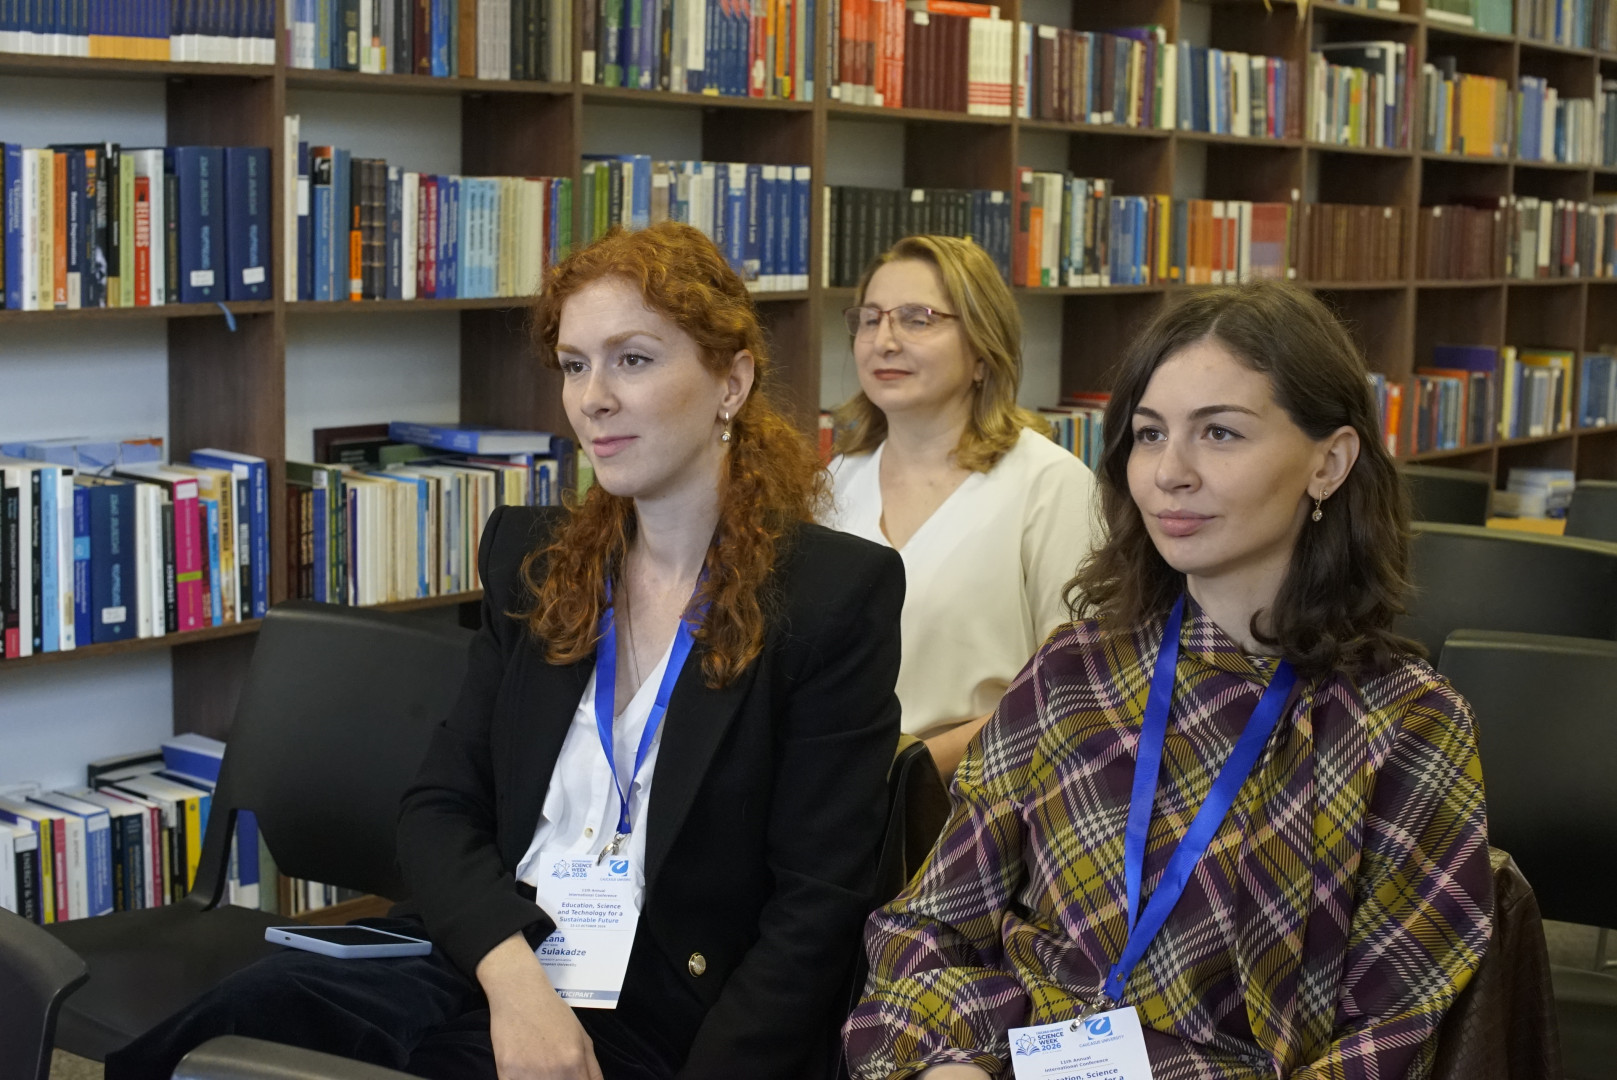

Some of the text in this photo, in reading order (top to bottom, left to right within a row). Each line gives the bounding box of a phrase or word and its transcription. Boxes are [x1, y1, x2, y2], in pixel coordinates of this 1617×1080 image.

[748, 173, 758, 244] International Law
[135, 201, 150, 247] BELARUS
[732, 202, 741, 245] International
[256, 468, 264, 514] Policy Analysis
[241, 523, 250, 566] INTELLIGENCE
[23, 852, 33, 887] ENERGY
[571, 909, 606, 917] Technology
[541, 948, 587, 956] Sulakadze
[557, 990, 595, 999] RTICIPANT
[1038, 1032, 1064, 1040] SCIENCE
[1102, 1035, 1124, 1043] UNIVERSITY
[1042, 1043, 1062, 1051] 2026
[1045, 1058, 1108, 1073] International Conference
[1087, 1069, 1119, 1079] Science
